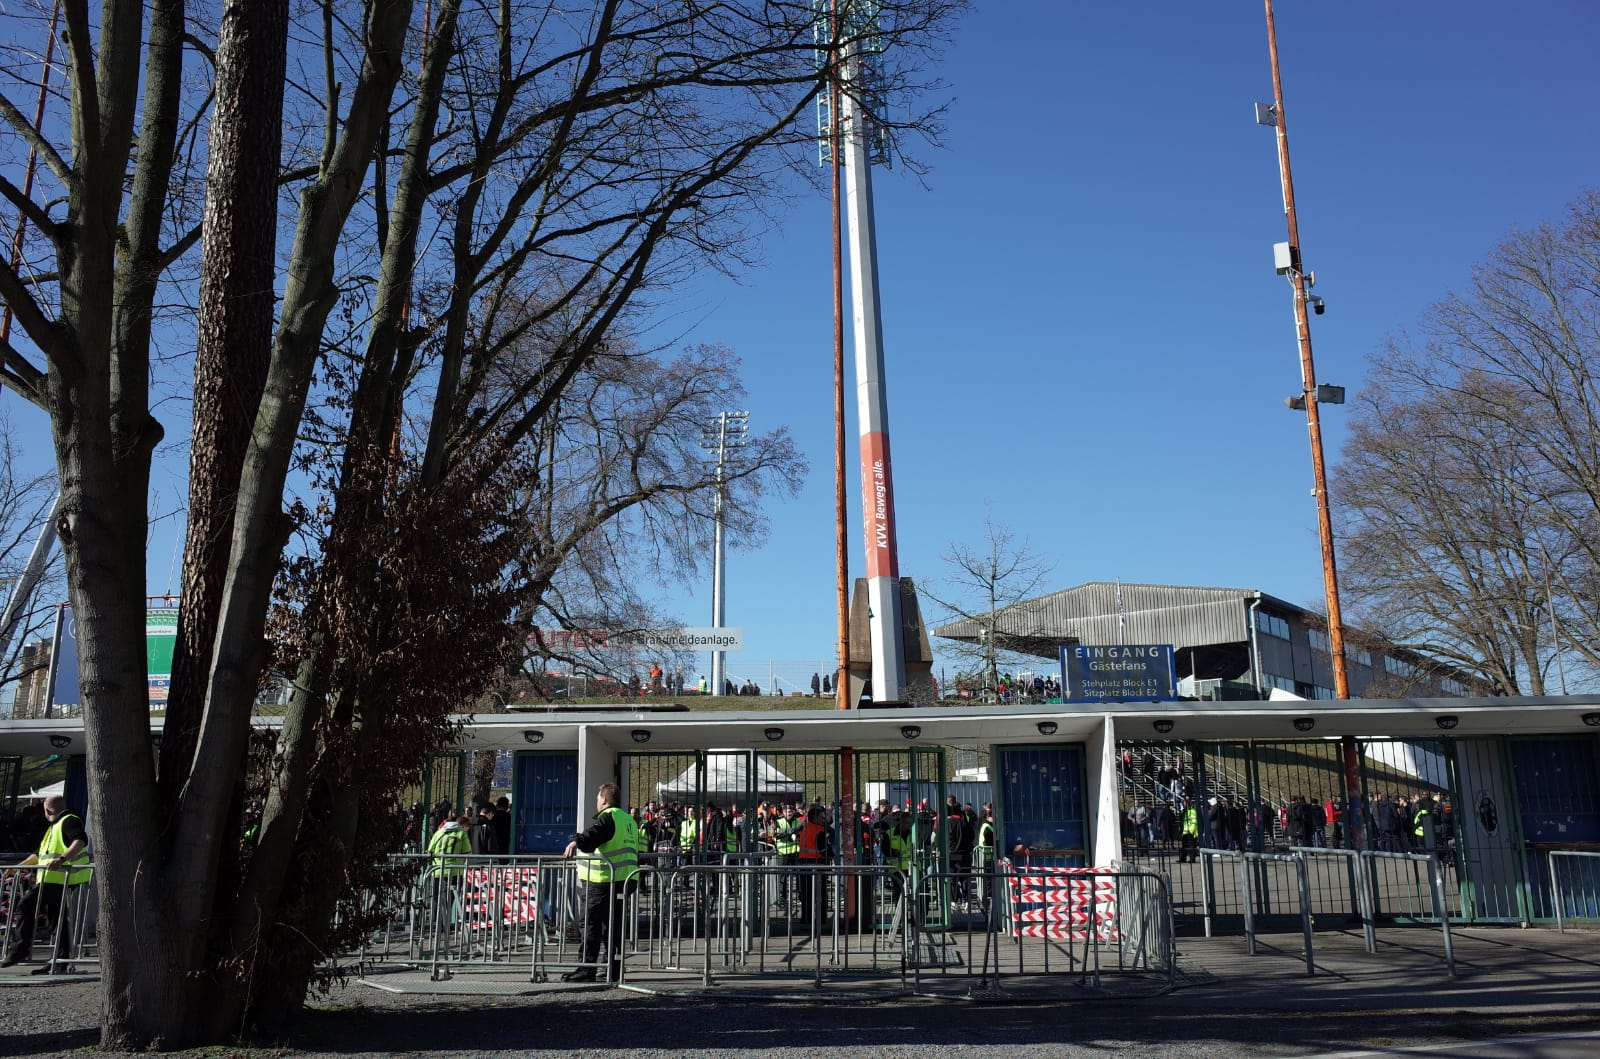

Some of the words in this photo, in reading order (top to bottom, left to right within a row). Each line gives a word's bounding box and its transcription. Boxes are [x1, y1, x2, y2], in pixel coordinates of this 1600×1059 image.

[872, 459, 883, 479] alle.
[875, 481, 886, 520] Bewegt
[876, 522, 887, 548] KVV.
[1075, 646, 1159, 658] EINGANG
[1089, 660, 1147, 671] Gästefans
[1081, 679, 1120, 689] Stehplatz
[1123, 679, 1145, 687] Block
[1147, 678, 1157, 687] E1
[1084, 689, 1120, 699] Sitzplatz
[1122, 689, 1145, 697] Block
[1146, 688, 1158, 697] E2
